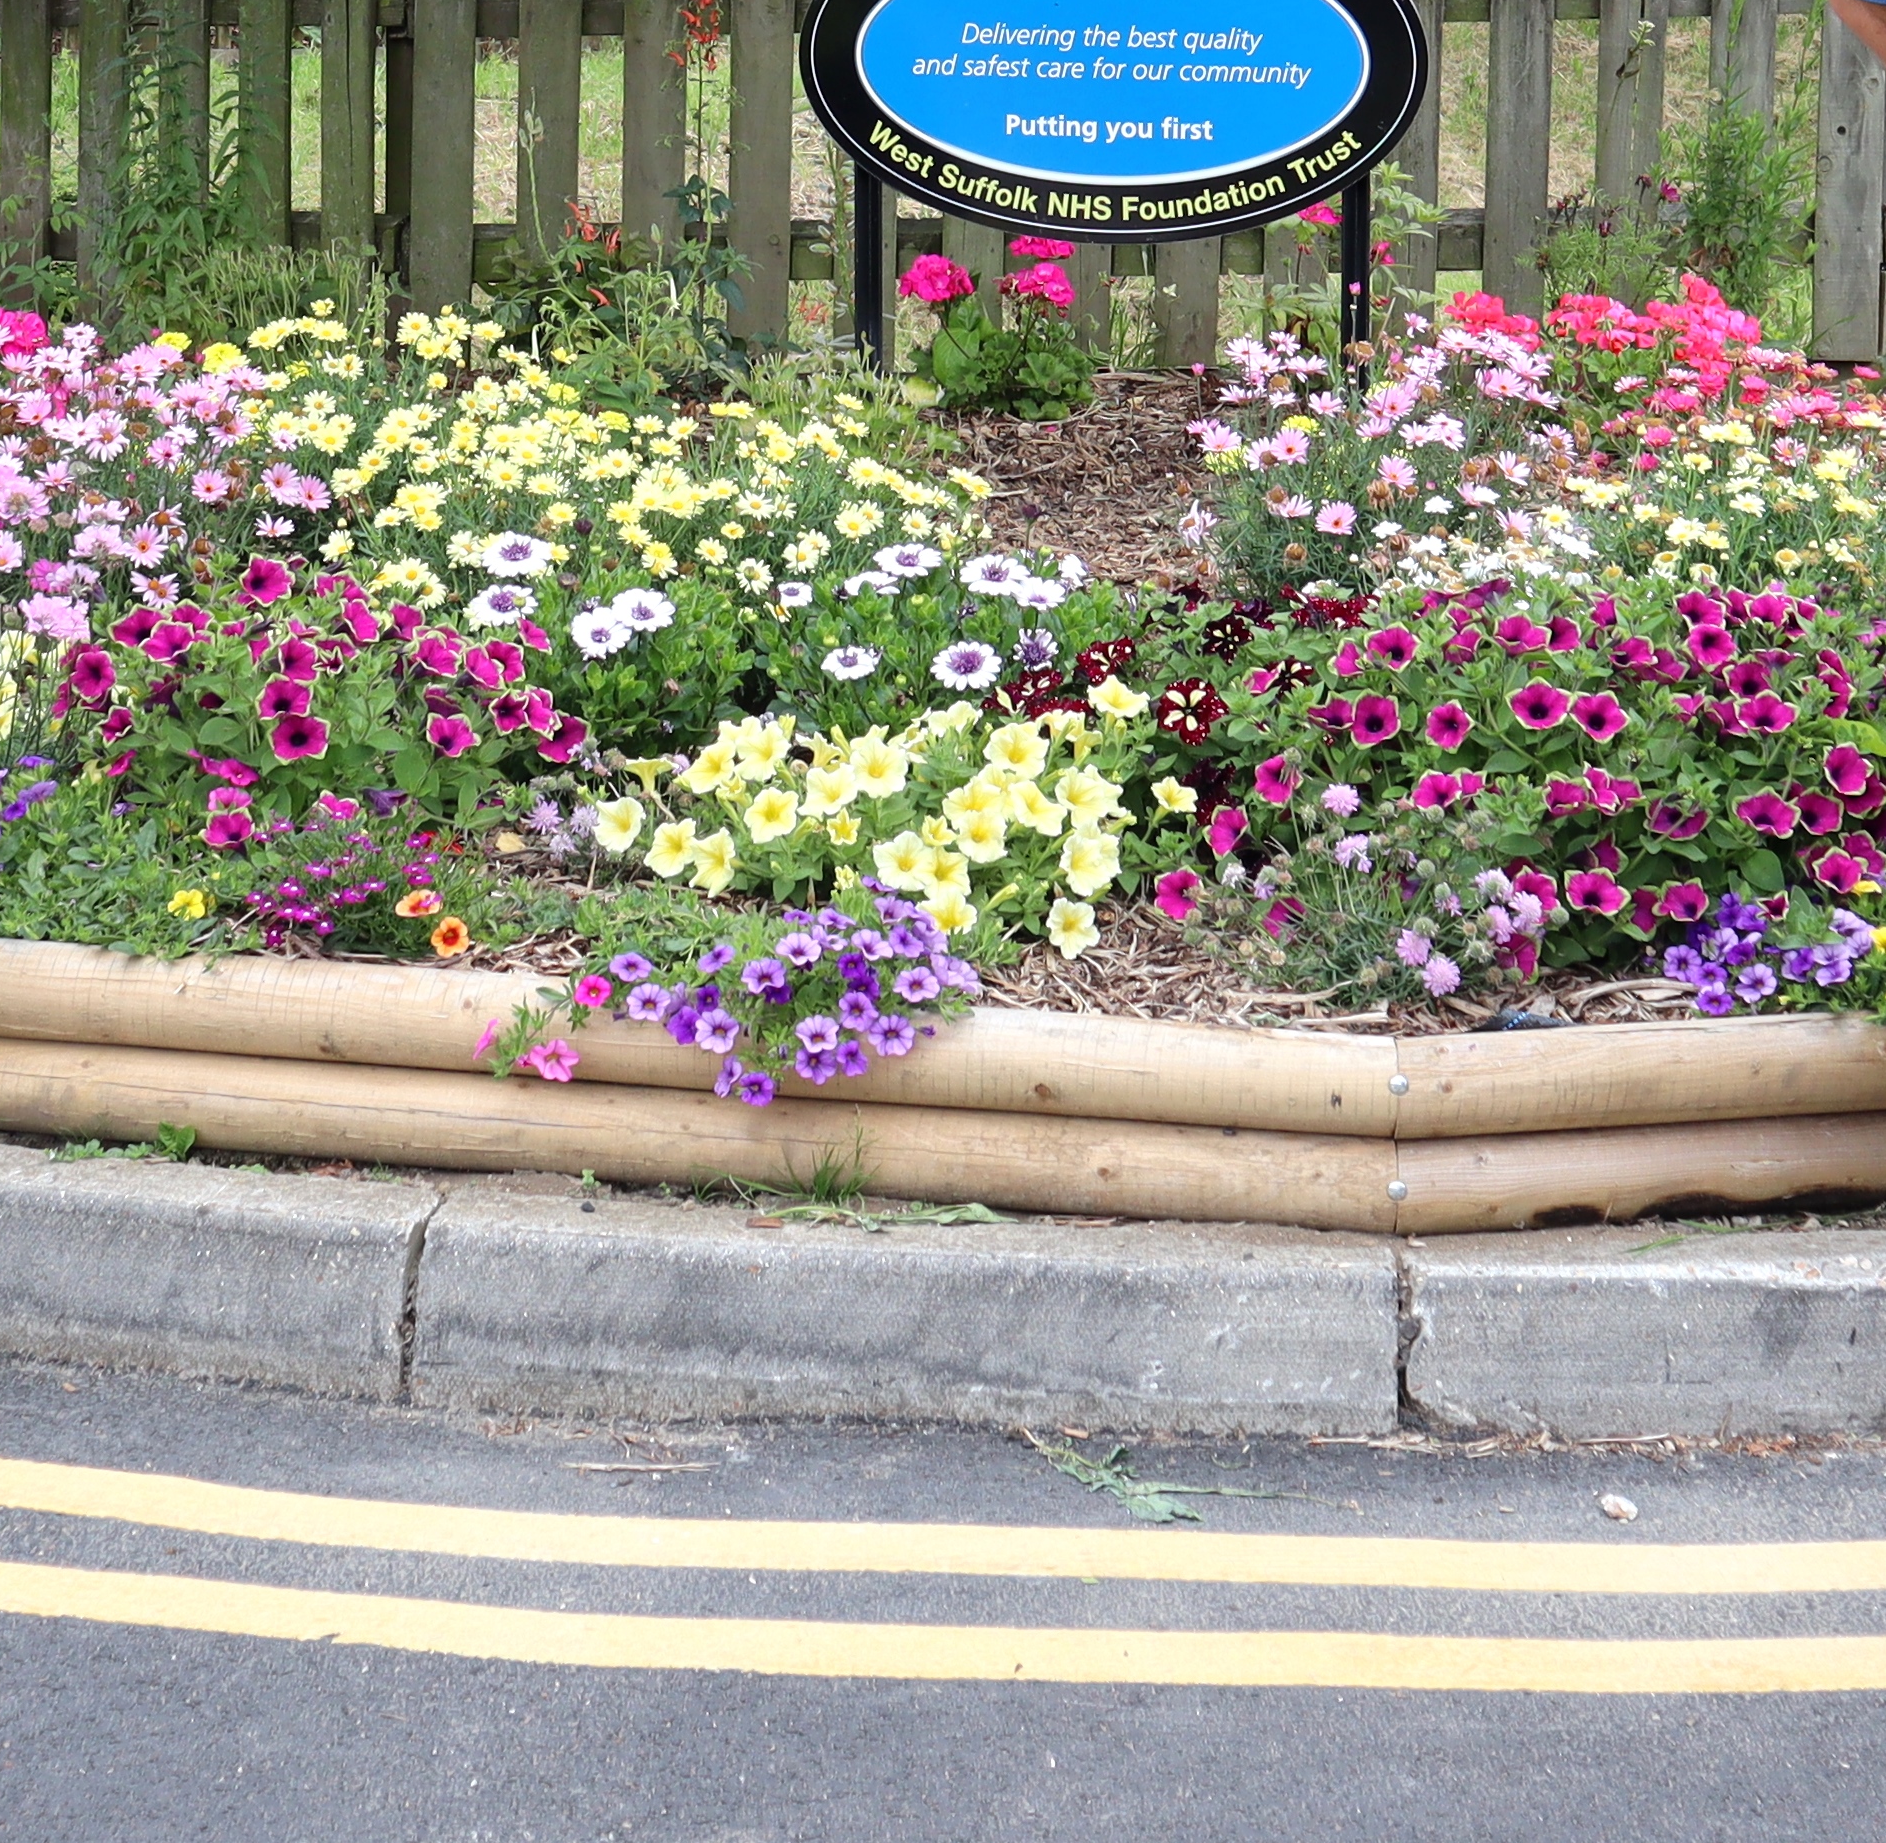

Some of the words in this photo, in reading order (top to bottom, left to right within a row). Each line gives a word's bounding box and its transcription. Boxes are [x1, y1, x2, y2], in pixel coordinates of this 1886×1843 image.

[961, 22, 1076, 52] Delivering
[1083, 25, 1120, 48] the
[1127, 26, 1177, 49] best
[1184, 27, 1263, 56] quality
[912, 54, 958, 76] and
[962, 54, 1031, 78] safest
[1036, 60, 1084, 79] care
[1092, 56, 1127, 80] for
[1132, 64, 1174, 82] our
[1179, 62, 1312, 90] community
[1005, 113, 1098, 140] Putting
[1105, 121, 1153, 143] you
[1161, 117, 1214, 141] first
[869, 119, 934, 178] West
[937, 162, 1037, 214] Suffolk
[1047, 191, 1113, 221] NHS
[1122, 174, 1285, 221] Foundation
[1287, 129, 1363, 185] Trust
